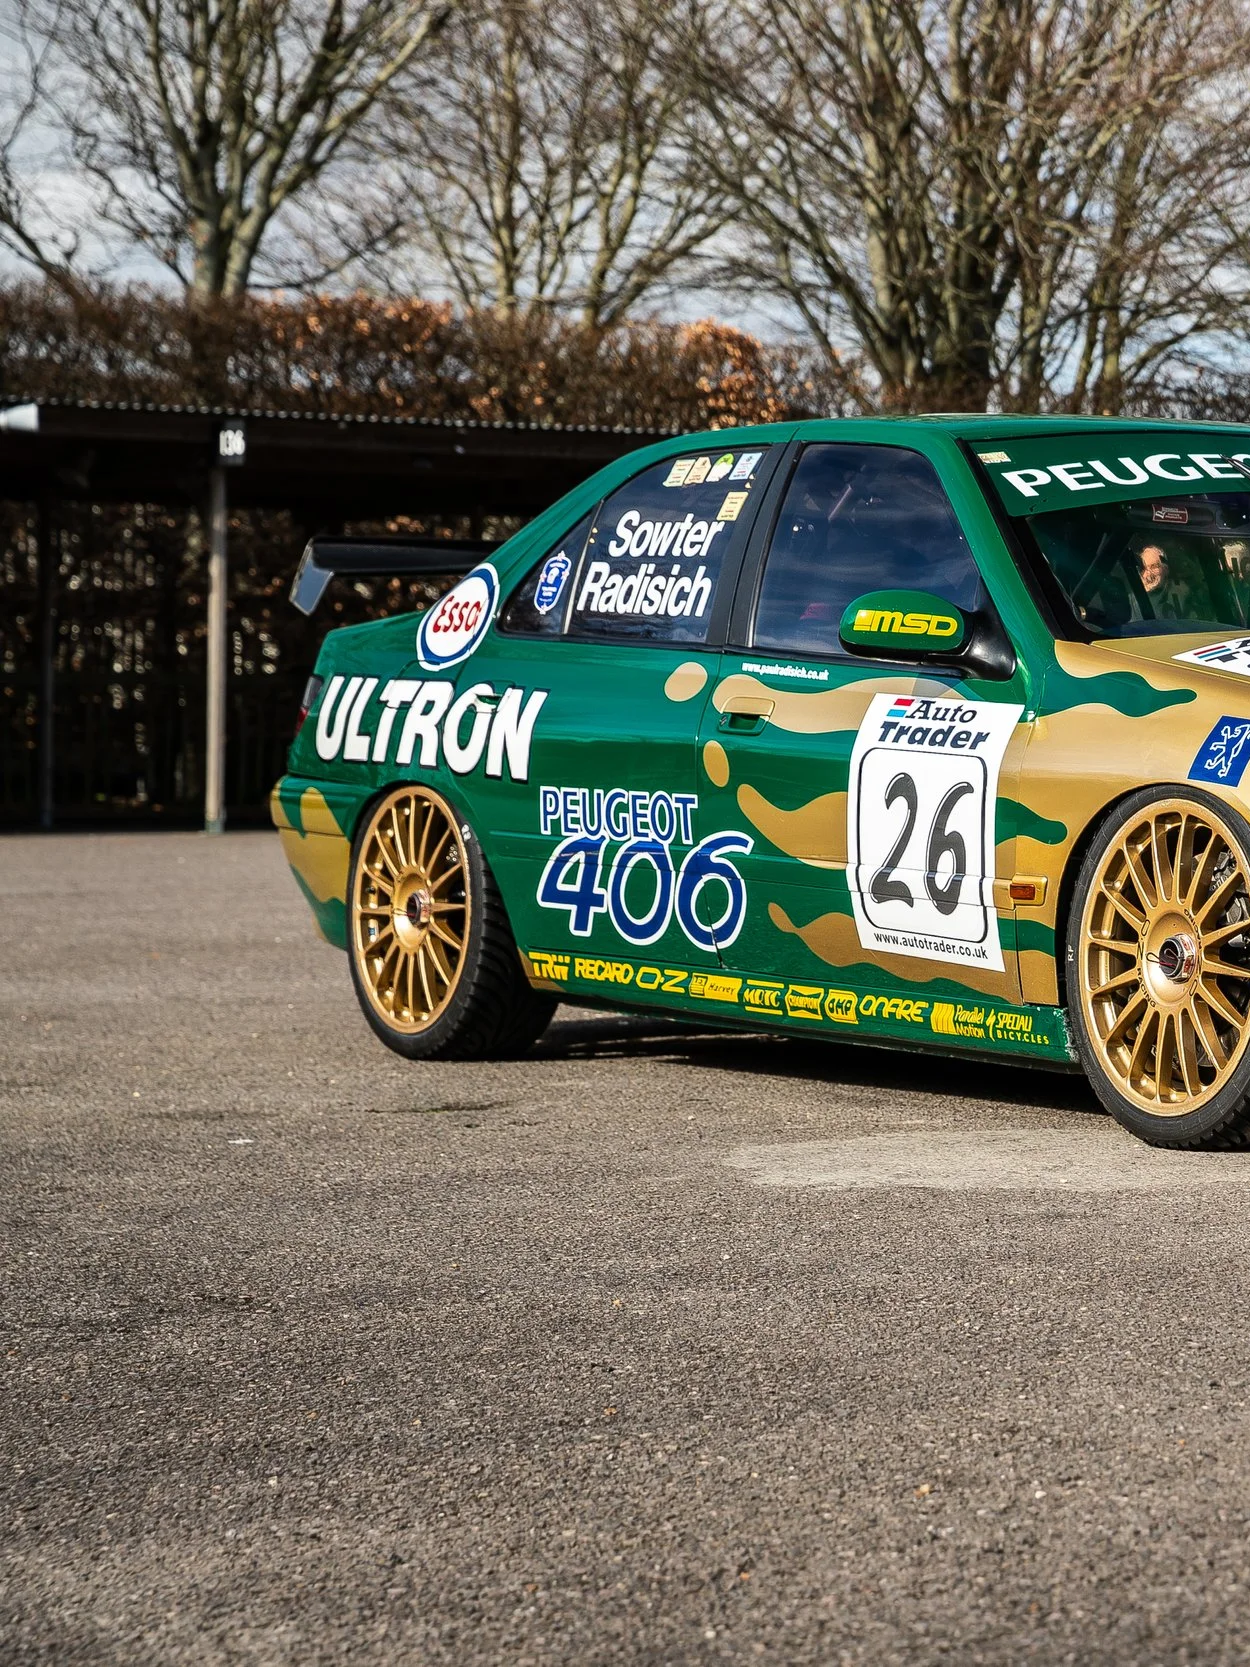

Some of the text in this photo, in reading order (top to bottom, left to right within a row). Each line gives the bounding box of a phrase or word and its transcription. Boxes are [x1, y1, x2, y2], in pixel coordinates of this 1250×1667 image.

[608, 509, 726, 557] Sowter
[576, 561, 712, 617] Radisich
[315, 675, 549, 781] ULTRON
[905, 699, 978, 724] Auto
[878, 720, 990, 750] Trader
[540, 786, 698, 845] PEUGEOT
[868, 771, 975, 916] 26
[537, 829, 755, 953] 406
[873, 932, 988, 960] www.autotrader.co.uk
[574, 957, 634, 985] RECARO
[955, 1022, 986, 1039] Motion
[997, 1030, 1050, 1045] BICYCLES
